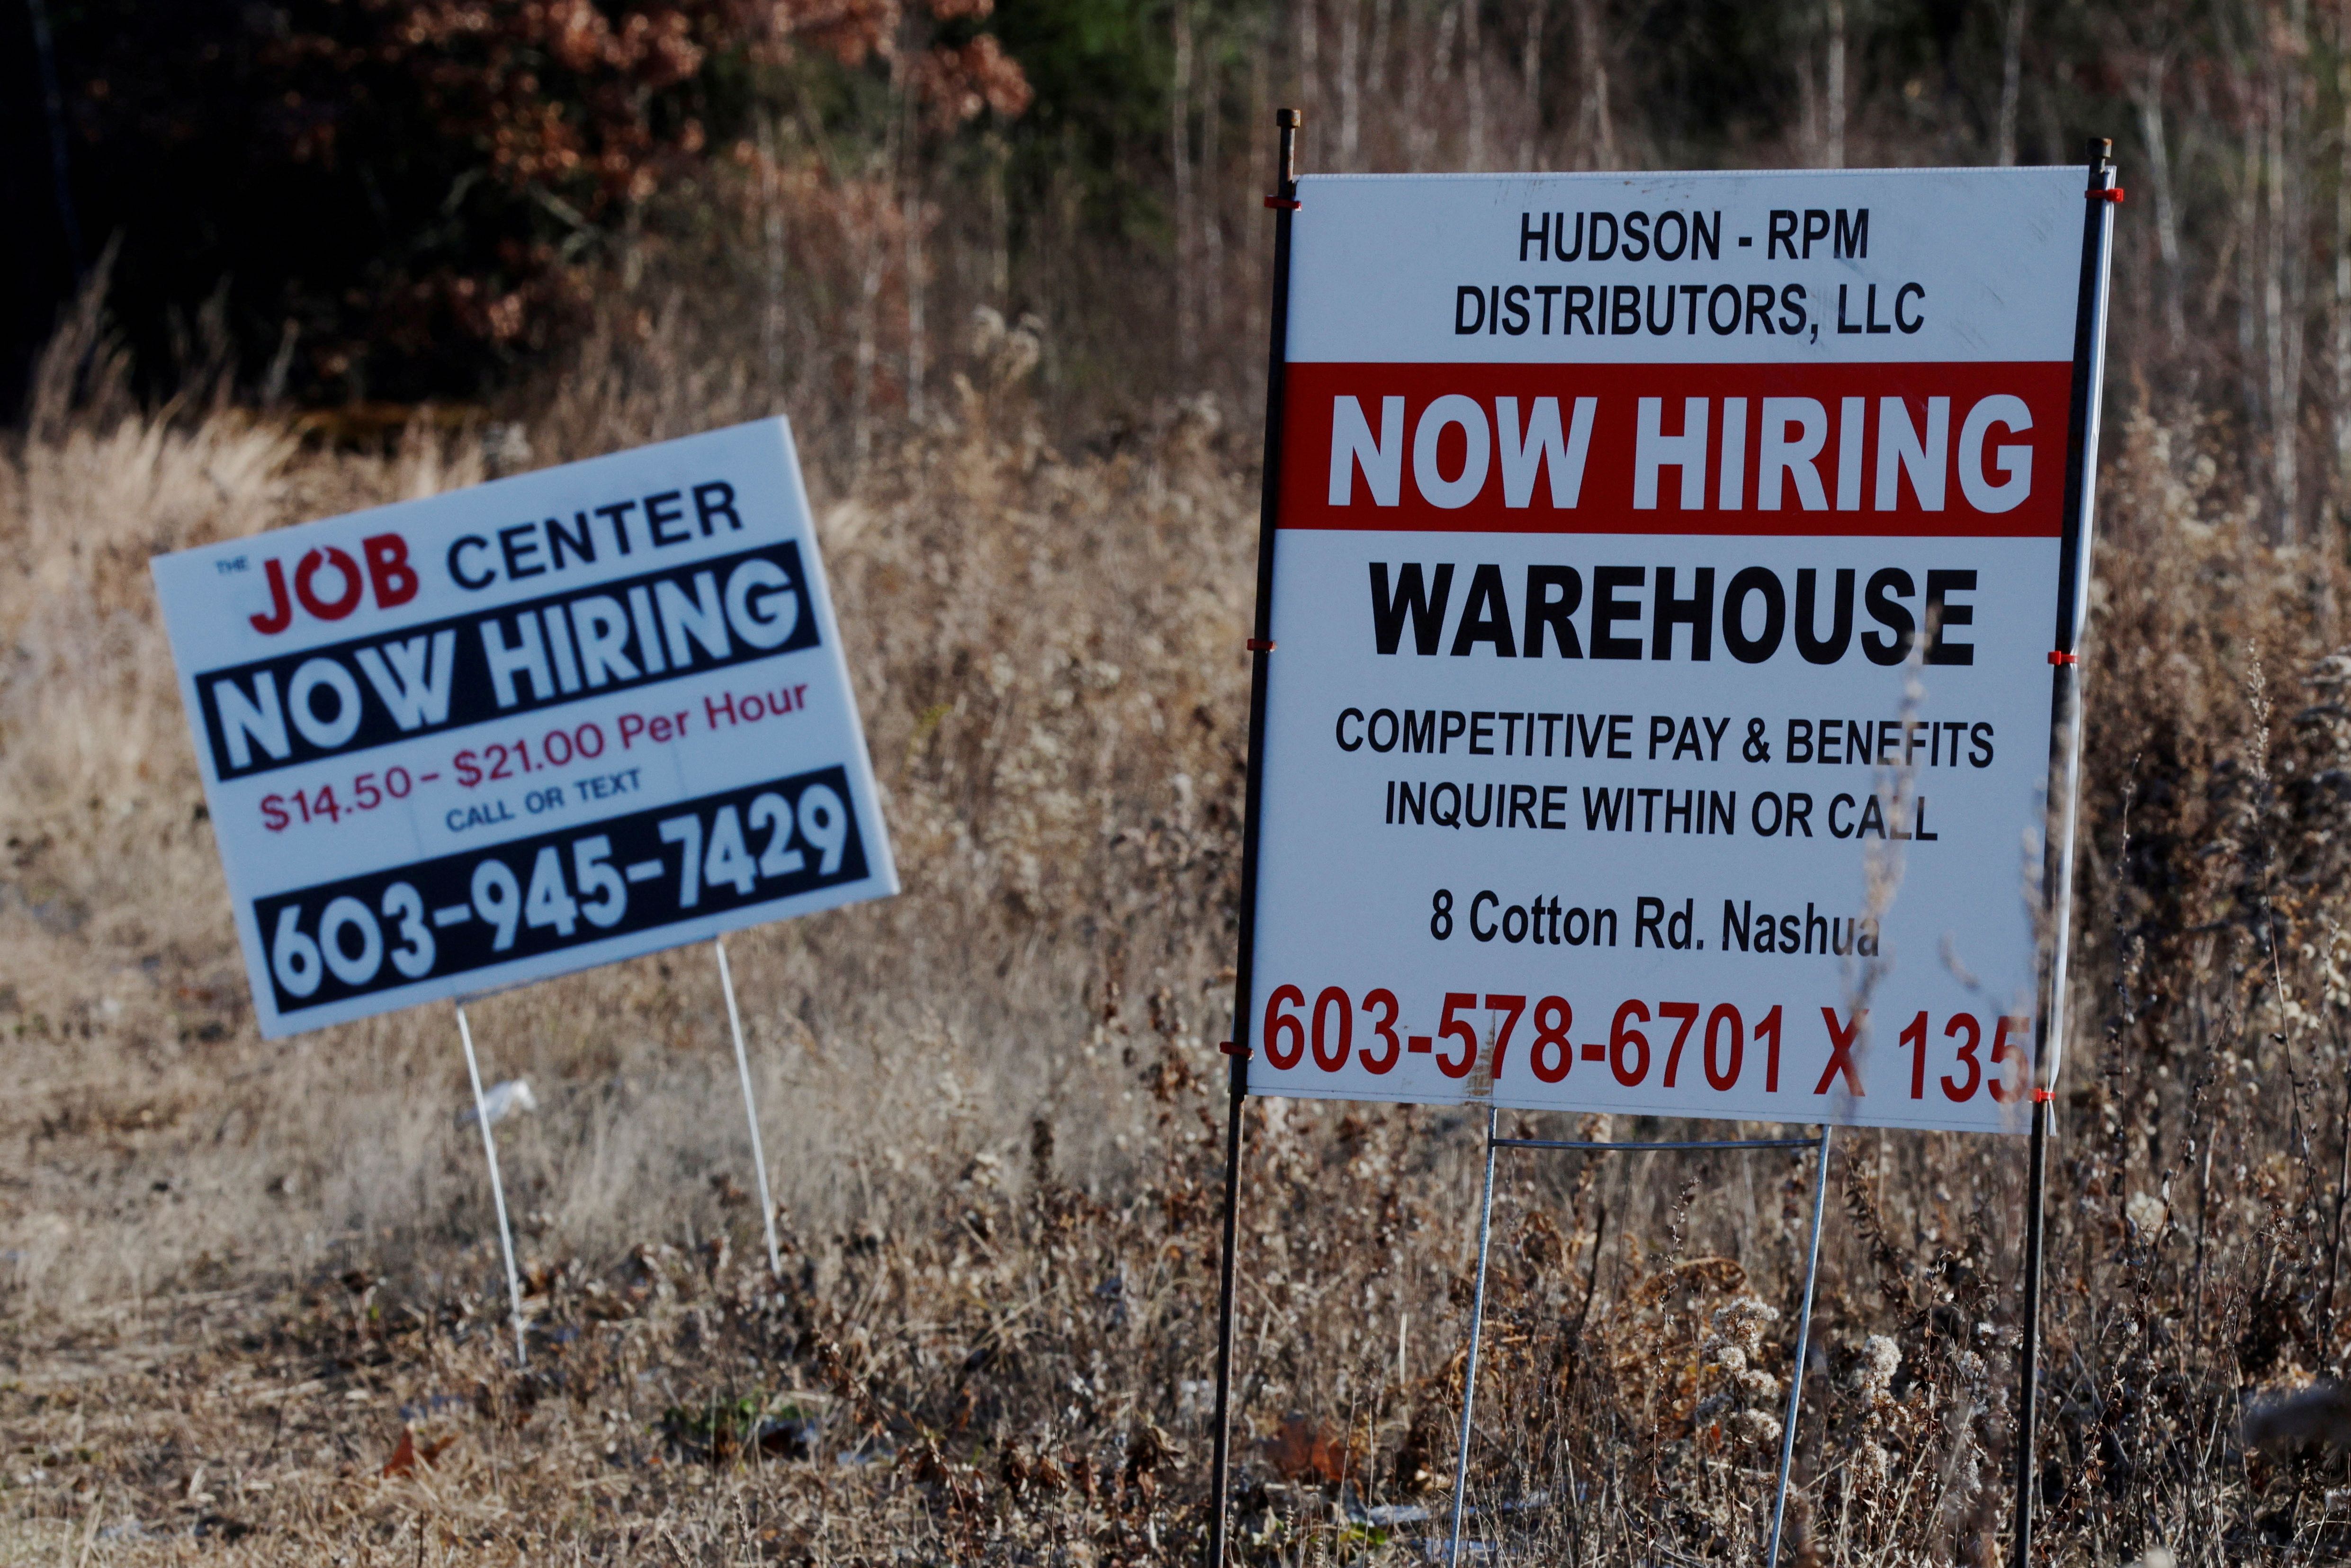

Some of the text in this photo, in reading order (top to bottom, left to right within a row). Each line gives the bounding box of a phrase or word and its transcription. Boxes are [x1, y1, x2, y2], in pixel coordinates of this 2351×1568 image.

[1519, 210, 1722, 261] HUDSON
[1768, 208, 1869, 260] RPM
[1454, 282, 1926, 345] DISTRIBUTORS, LLC
[1328, 393, 2034, 513] NOW HIRING
[249, 532, 419, 635] JOB
[446, 481, 743, 590] CENTER
[212, 559, 799, 770] NOW HIRING
[1368, 562, 1978, 666] WAREHOUSE
[453, 723, 604, 788] $21.00
[618, 710, 691, 749] Per
[704, 683, 808, 729] Hour
[1335, 707, 1994, 769] COMPETITIVE PAY & BENEFITS
[446, 768, 641, 832] CALL OR TEXT
[1385, 780, 1938, 842] INQUIRE WITHIN OR CALL
[272, 783, 846, 997] 603-945-7429
[1430, 888, 1879, 958] 8 Cotton Rd. Nashua
[1264, 984, 2030, 1104] 603-578-6701 X 135
